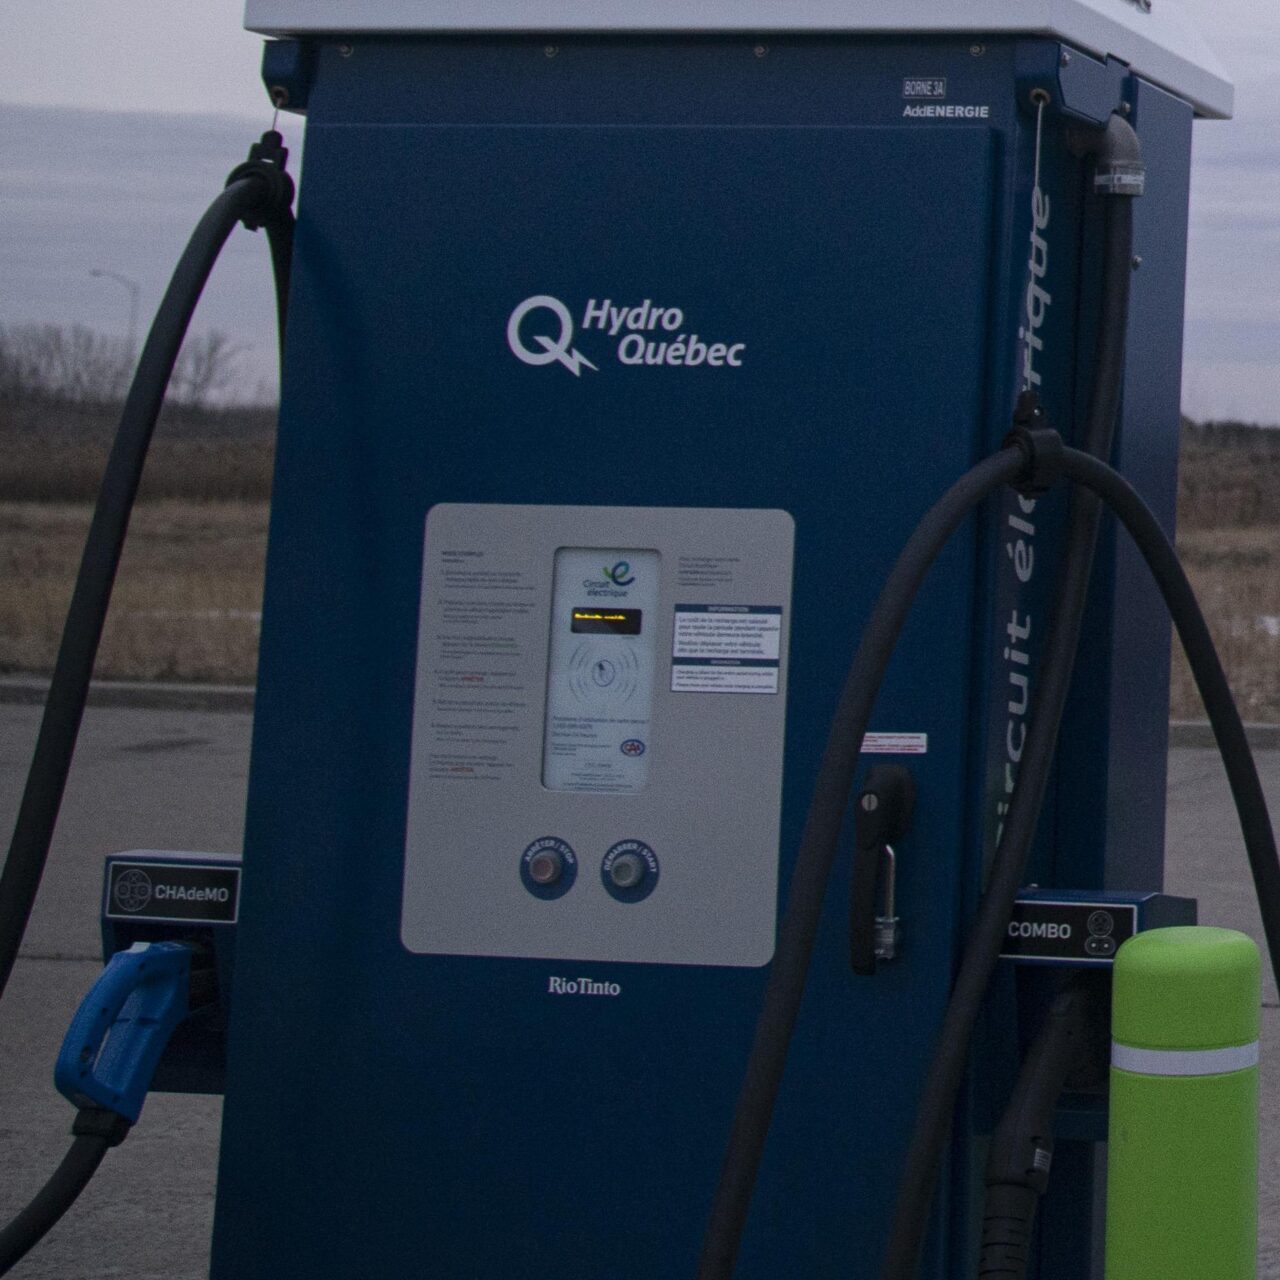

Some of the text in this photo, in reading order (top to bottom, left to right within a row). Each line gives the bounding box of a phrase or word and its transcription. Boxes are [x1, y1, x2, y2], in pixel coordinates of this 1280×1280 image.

[905, 81, 932, 95] BORNE
[903, 105, 989, 118] AddENERGIE
[582, 298, 684, 336] Hydro
[617, 333, 746, 367] Québec
[155, 884, 229, 902] CHAdeMO
[1008, 921, 1071, 939] COMBO
